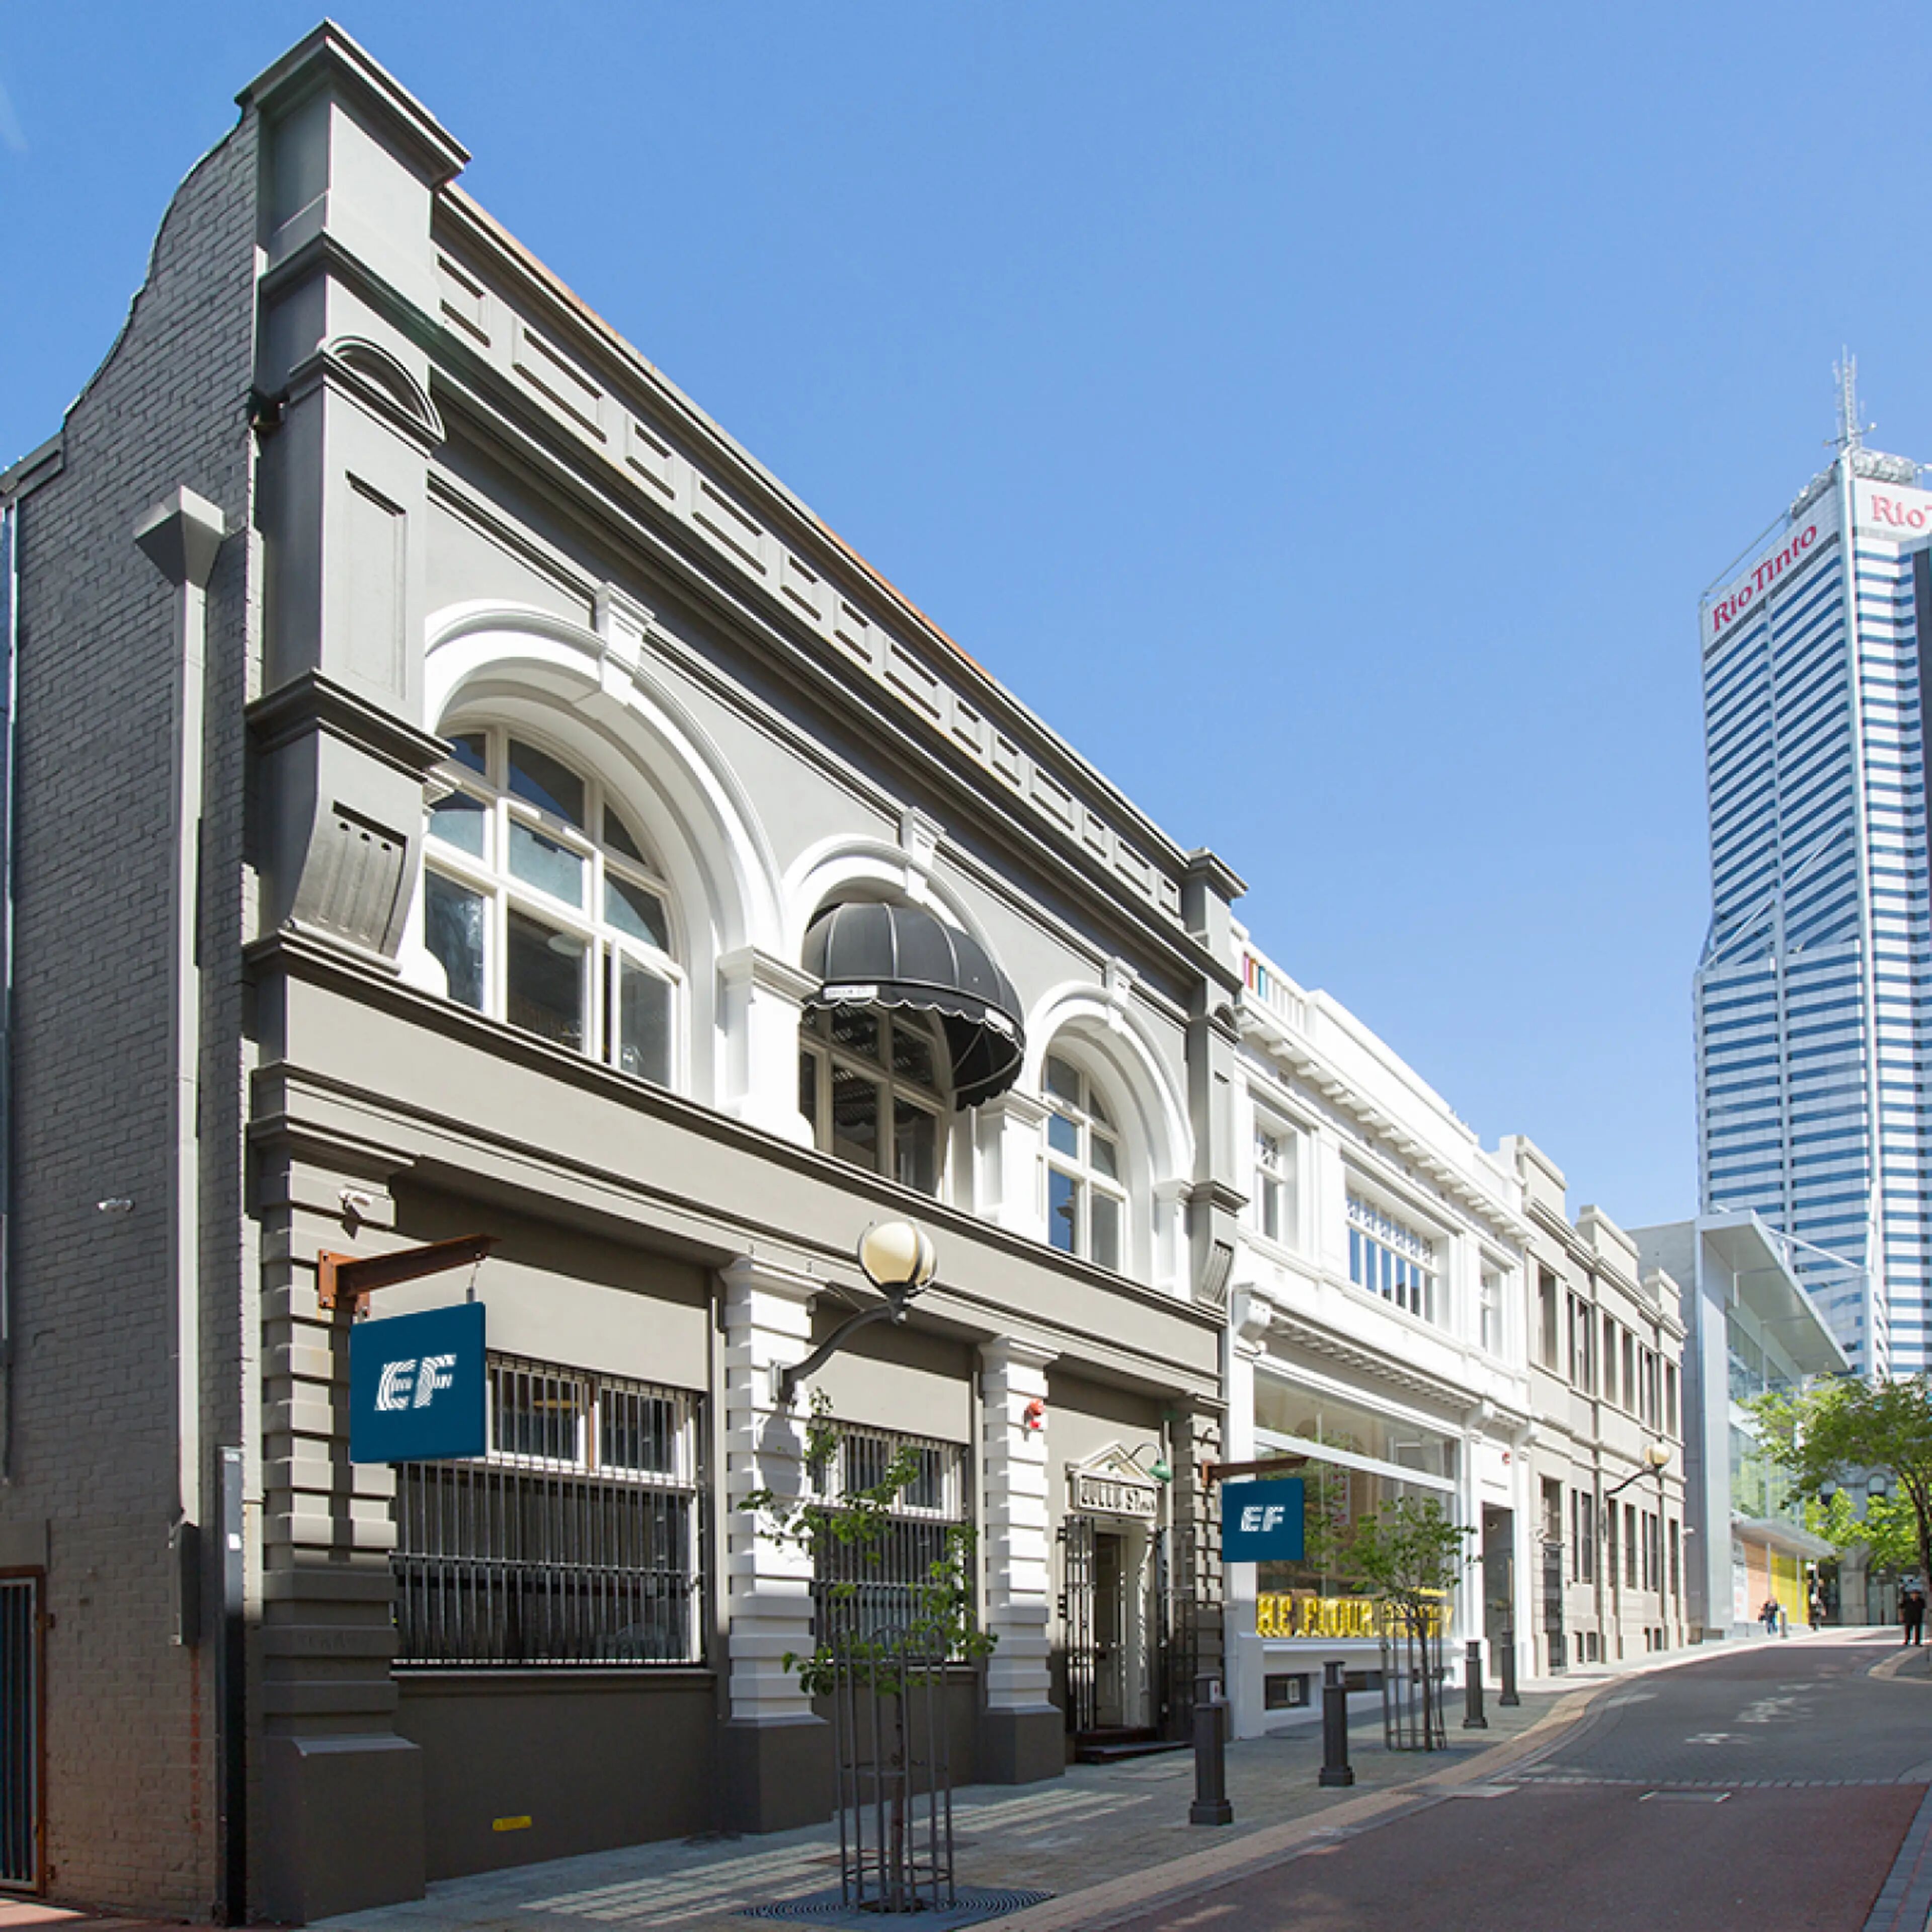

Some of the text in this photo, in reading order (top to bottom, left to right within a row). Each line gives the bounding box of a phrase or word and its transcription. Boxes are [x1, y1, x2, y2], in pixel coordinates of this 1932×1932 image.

[1871, 495, 1926, 529] Rio
[1713, 524, 1817, 632] Rio Tinto
[374, 1353, 457, 1411] EF
[1240, 1504, 1285, 1532] EF
